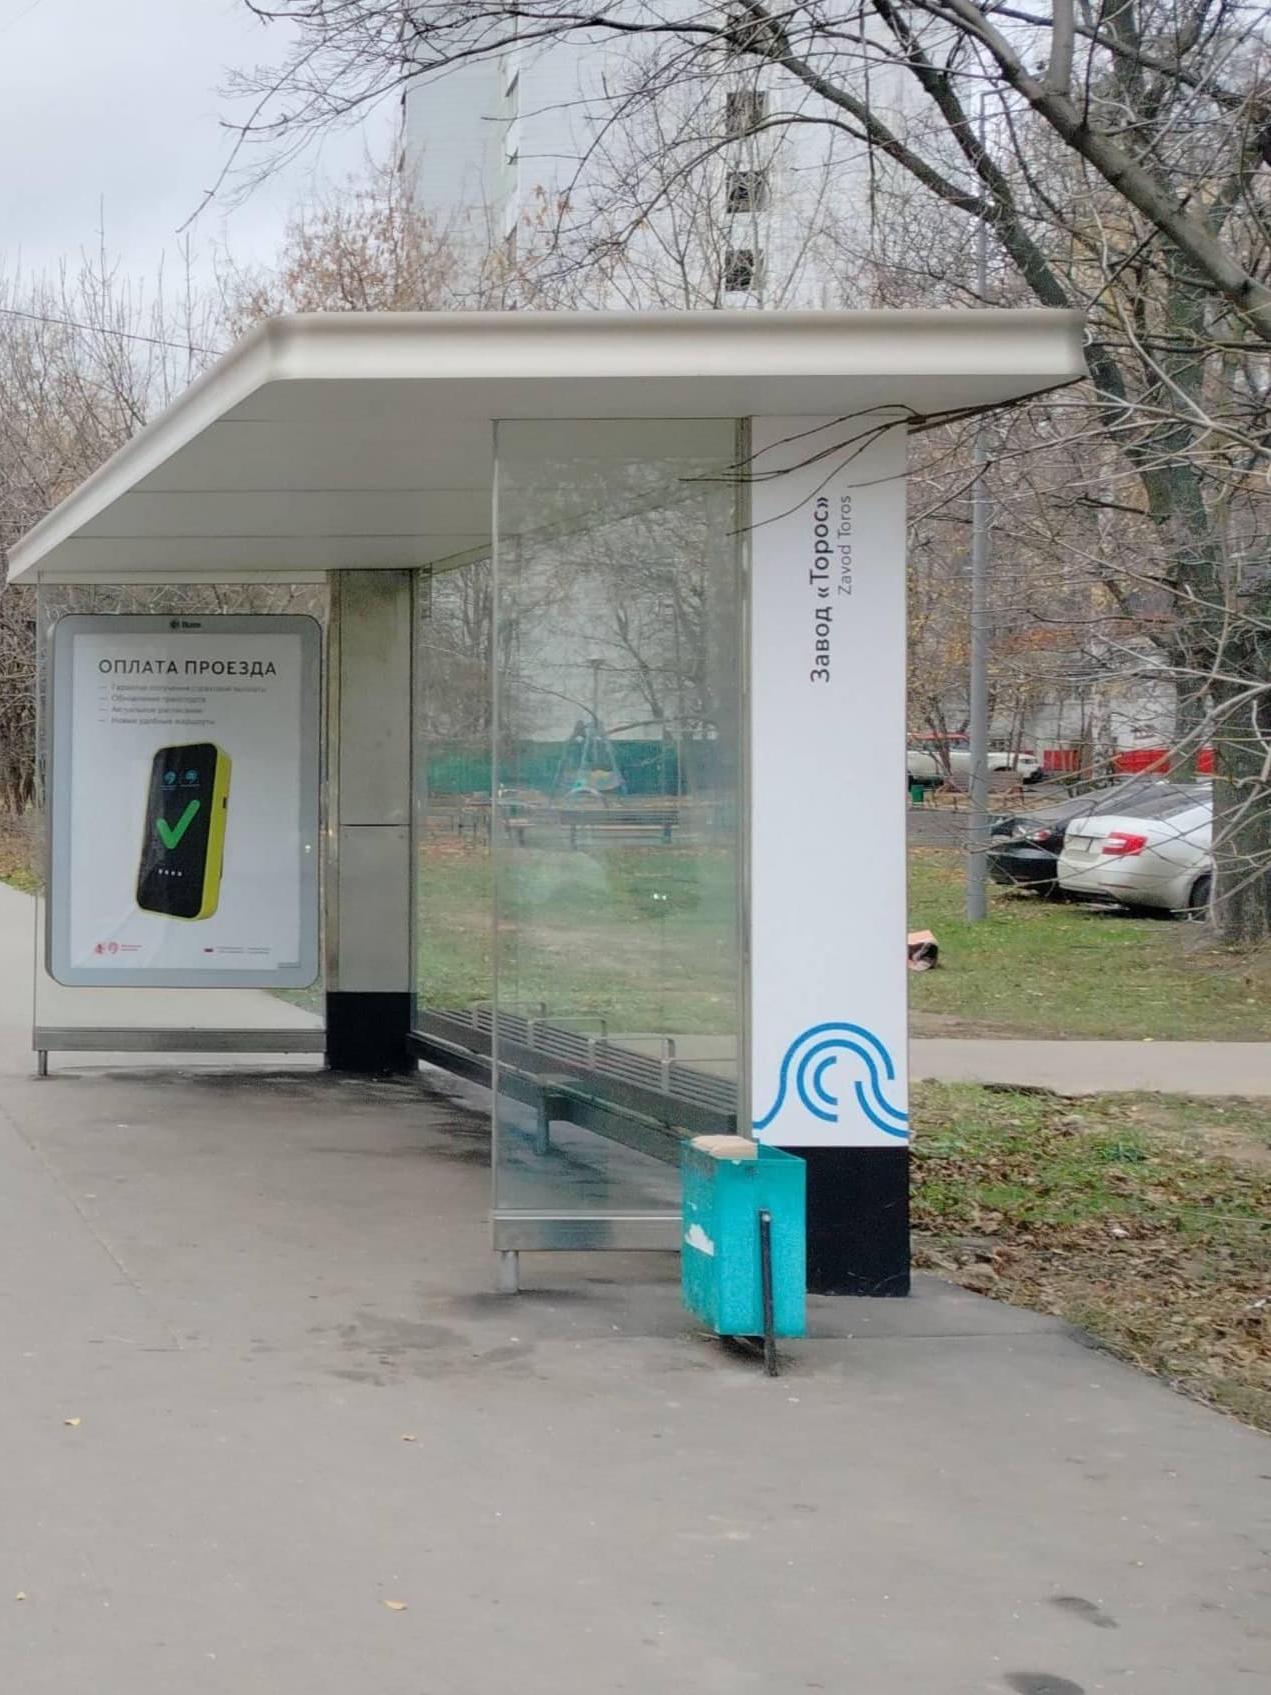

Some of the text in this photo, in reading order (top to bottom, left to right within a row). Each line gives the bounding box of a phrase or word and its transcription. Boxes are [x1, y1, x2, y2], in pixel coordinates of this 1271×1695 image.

[810, 496, 833, 683] Завод «Торос»
[838, 495, 852, 595] Zavod Toros
[98, 659, 277, 678] ОПЛАТА ПРОЕЗДА
